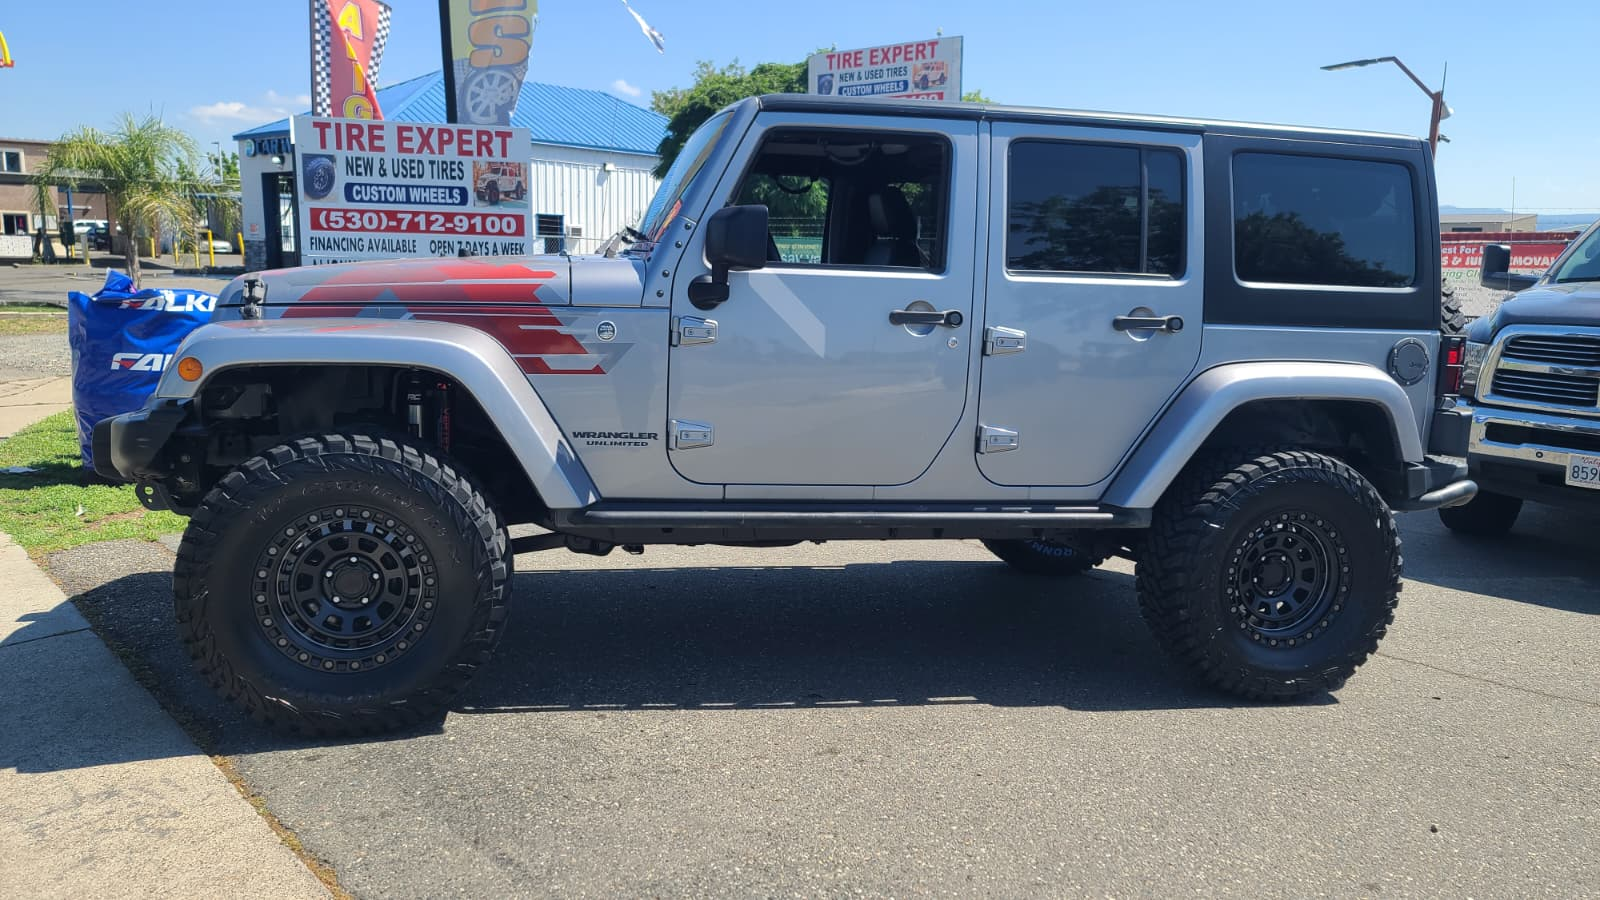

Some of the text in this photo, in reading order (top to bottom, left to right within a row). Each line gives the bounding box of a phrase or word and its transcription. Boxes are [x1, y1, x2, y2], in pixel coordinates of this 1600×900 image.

[826, 41, 939, 71] TIRE EXPERT
[839, 66, 908, 83] NEW & USED TIRES
[842, 81, 905, 96] CUSTOM WHEELS
[312, 121, 513, 158] TIRE EXPERT
[345, 156, 465, 181] NEW & USED TIRES
[352, 185, 461, 205] CUSTOM WHEELS
[319, 211, 517, 234] (530)-712-9100
[310, 236, 365, 252] FINANCING
[368, 239, 417, 253] AVAILABLE
[429, 240, 455, 254] OPEN
[492, 242, 499, 256] A
[501, 242, 525, 256] WEEK
[572, 431, 658, 440] WRANGLER
[1571, 465, 1600, 481] 859
